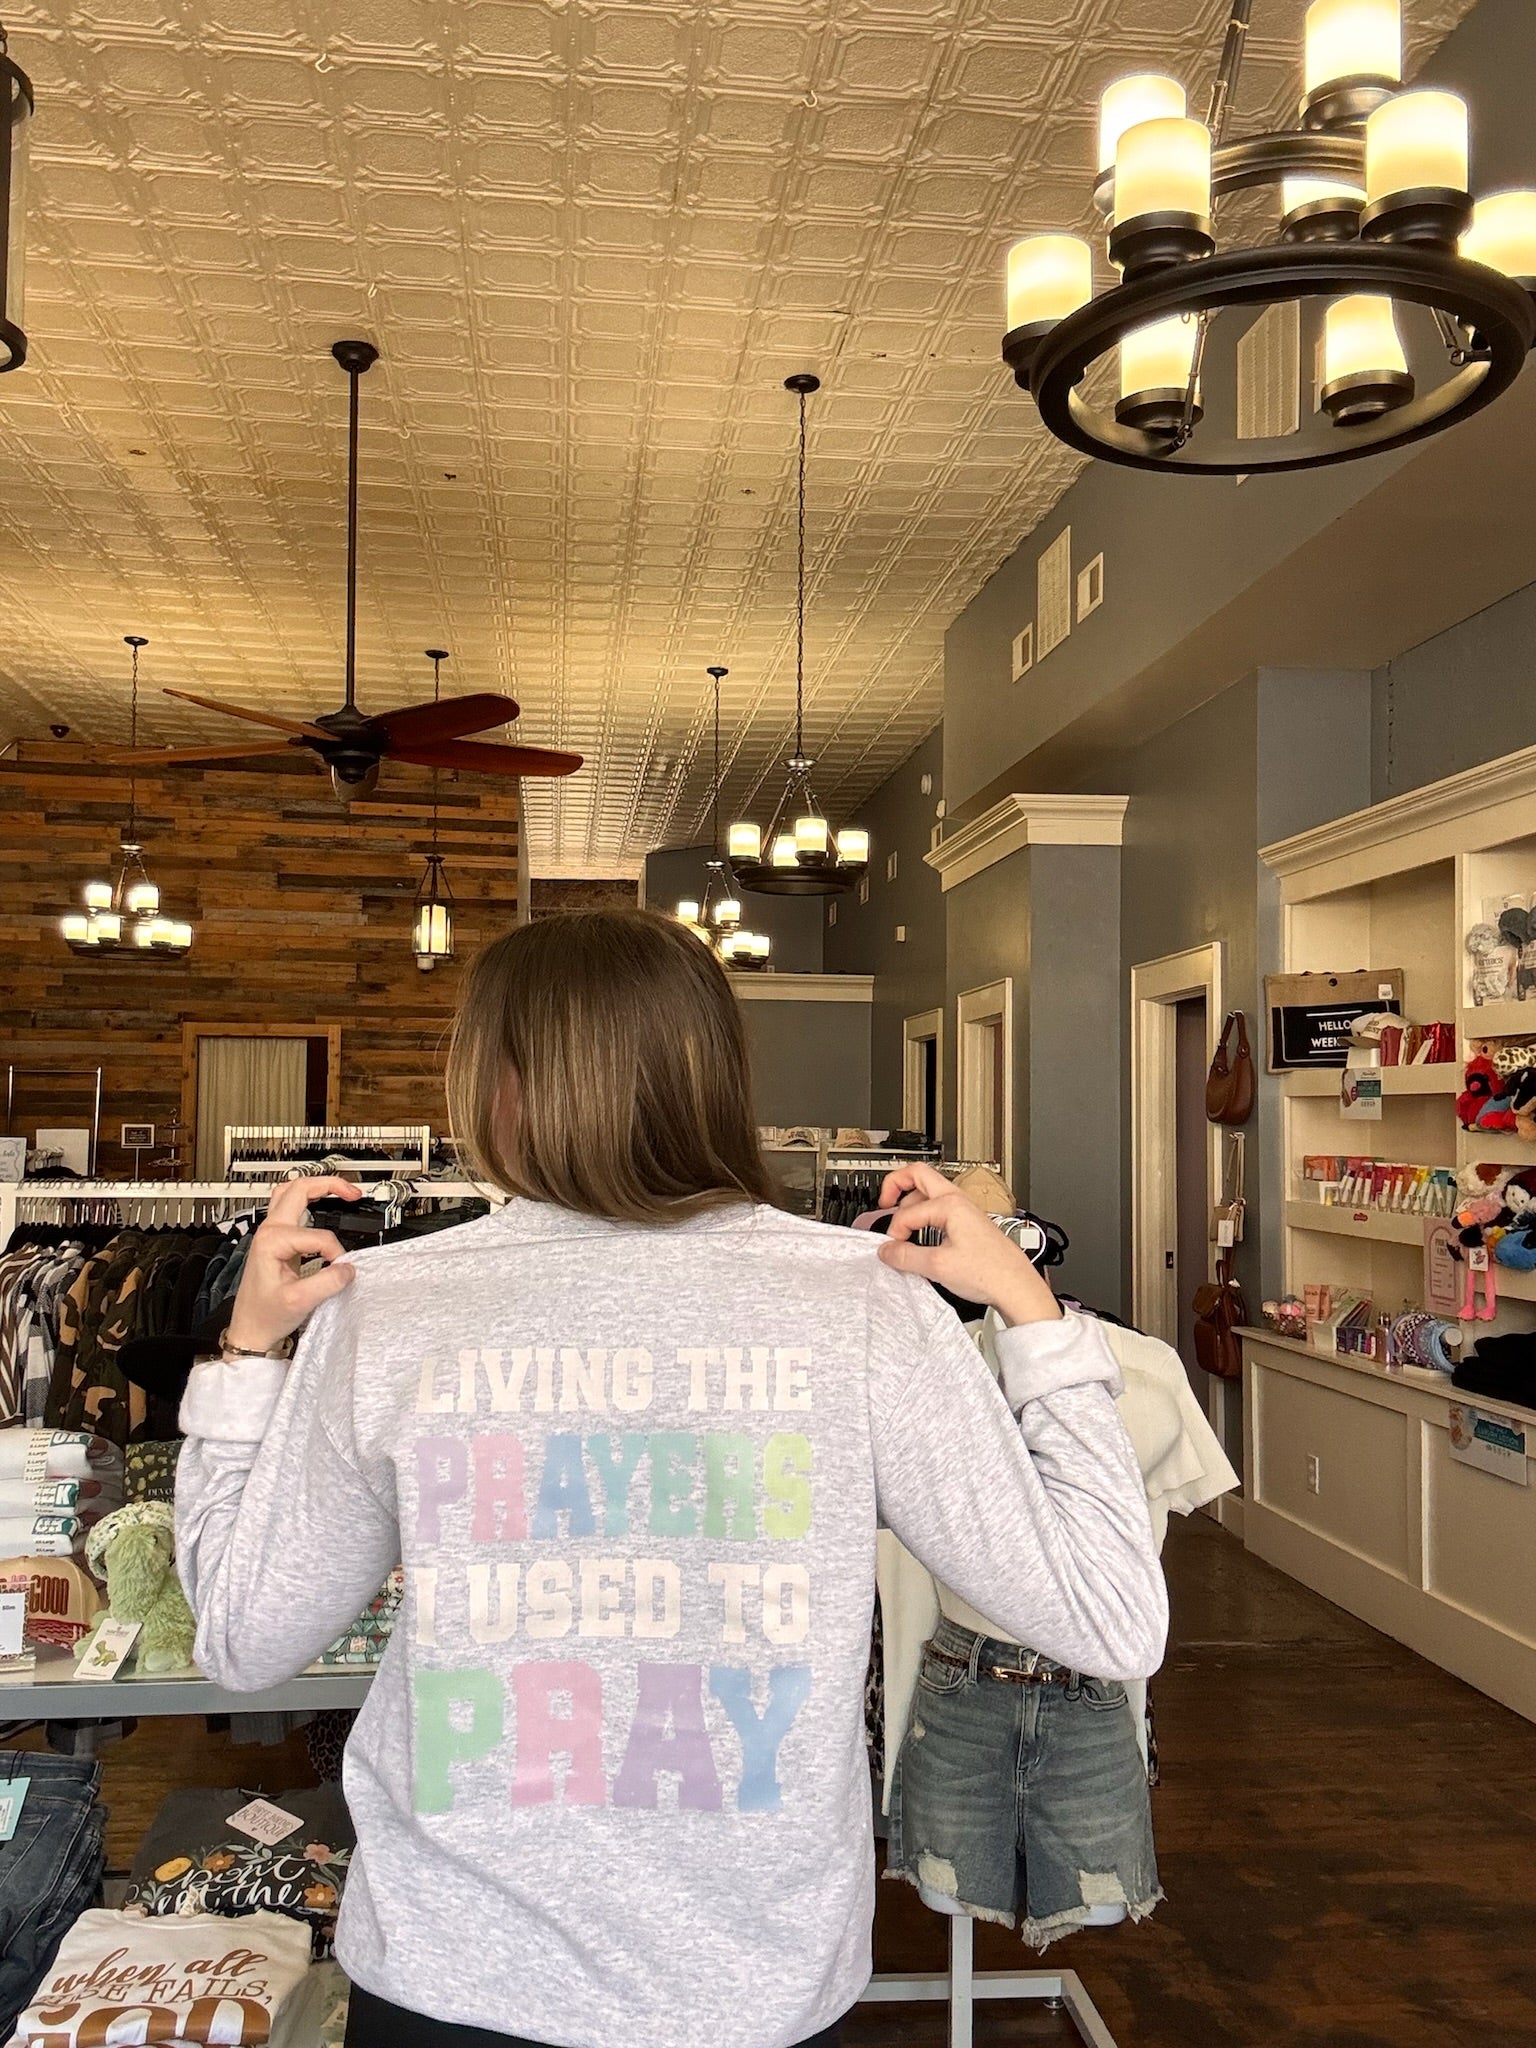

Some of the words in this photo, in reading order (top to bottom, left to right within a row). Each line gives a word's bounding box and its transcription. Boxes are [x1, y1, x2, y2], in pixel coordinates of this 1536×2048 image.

[1319, 1020, 1352, 1031] HELLO
[415, 1346, 653, 1413] LIVING
[677, 1347, 812, 1412] THE
[414, 1433, 813, 1541] PRAYERS
[414, 1567, 438, 1646] I
[466, 1558, 681, 1645] USED
[708, 1563, 810, 1644] TO
[413, 1661, 812, 1813] PRAY
[236, 1808, 288, 1838] BOUTIQUE
[221, 1878, 302, 1908] the
[51, 1947, 176, 1993] when
[184, 1949, 269, 1977] all
[141, 1978, 274, 2005] FAILS,
